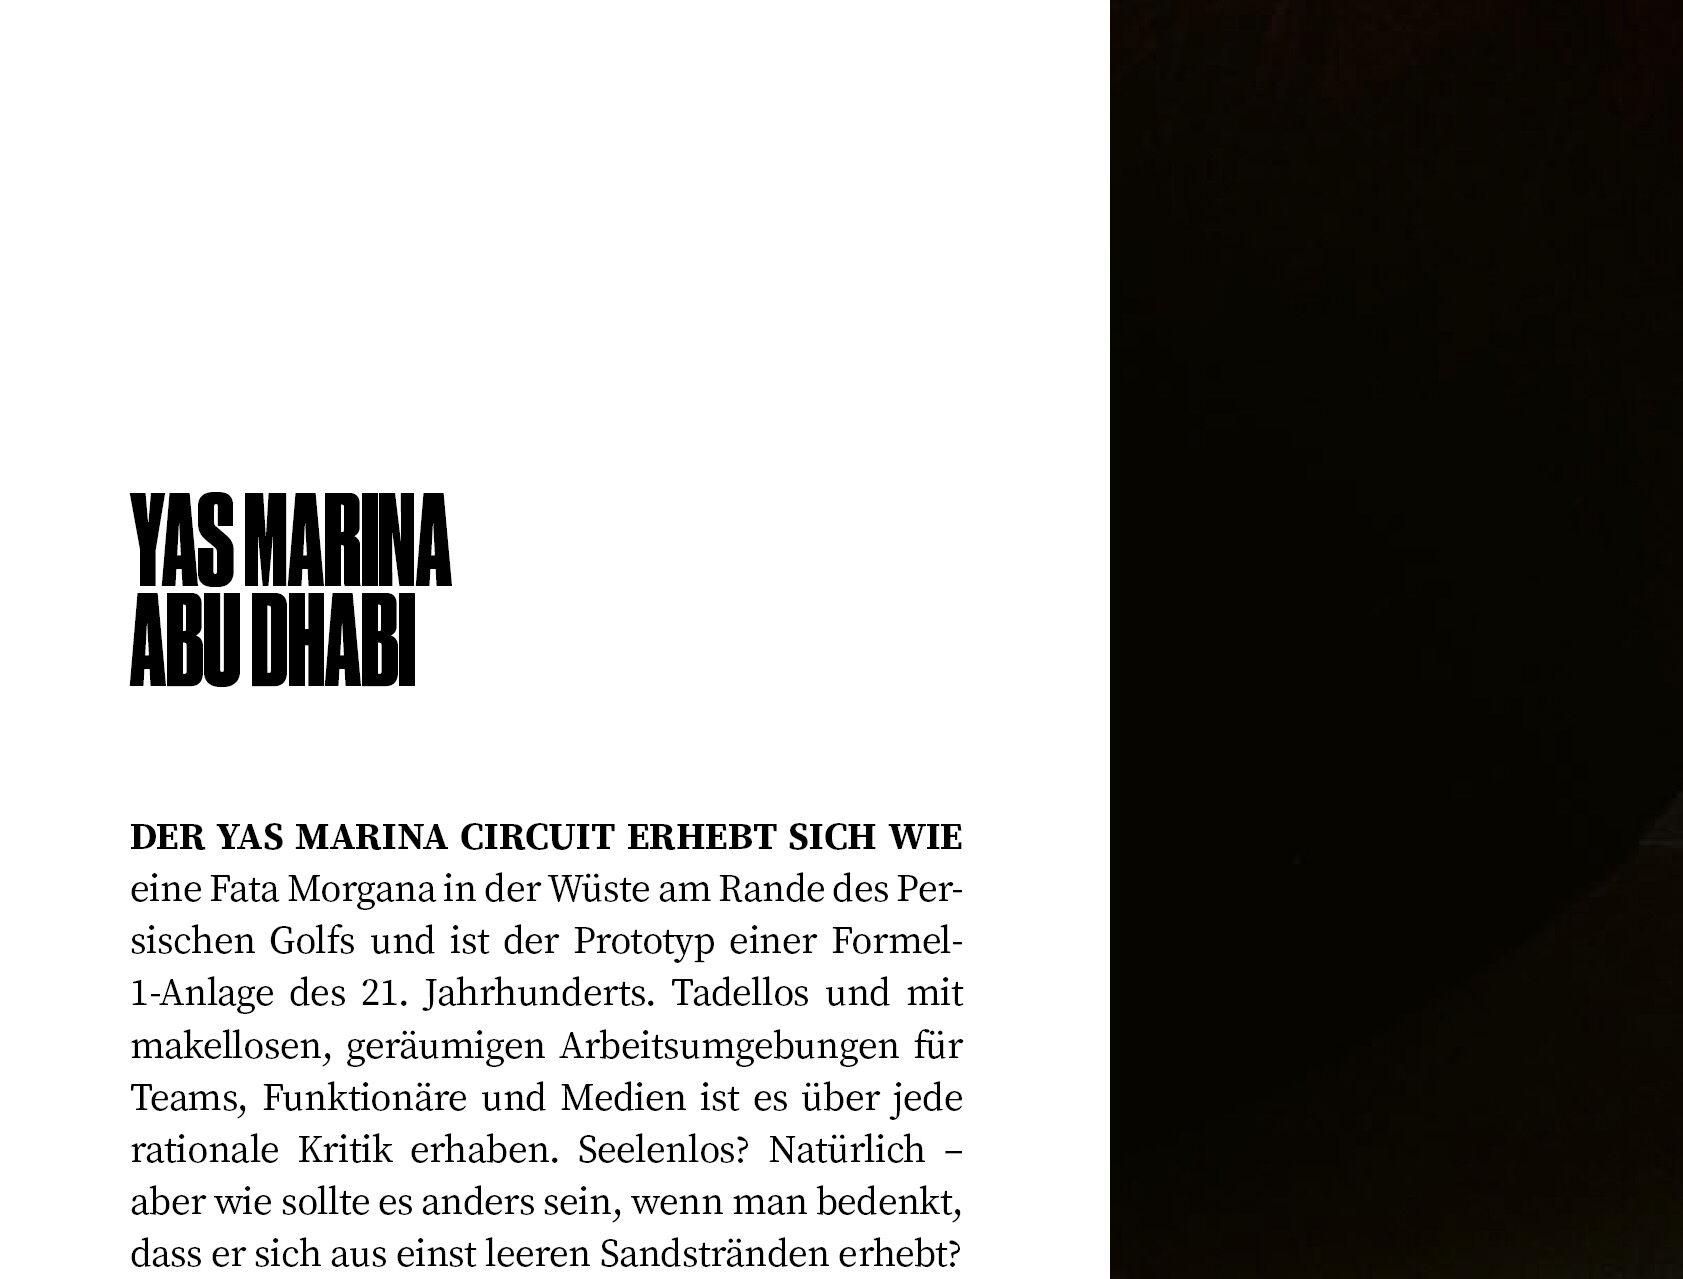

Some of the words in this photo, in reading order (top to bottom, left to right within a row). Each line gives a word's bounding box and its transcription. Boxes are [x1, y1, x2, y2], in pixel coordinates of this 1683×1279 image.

[130, 492, 234, 587] YAS
[245, 493, 452, 586] MARINA
[130, 593, 240, 687] ABU
[252, 593, 415, 686] DHABI
[131, 824, 205, 850] DER
[217, 823, 283, 850] YAS
[296, 824, 448, 850] MARINA
[461, 823, 615, 850] CIRCUIT
[628, 824, 777, 850] ERHEBT
[790, 823, 875, 850] SICH
[889, 824, 961, 849] WIE
[132, 873, 201, 902] eine
[211, 875, 279, 902] Fata
[289, 875, 436, 910] Morgana
[444, 873, 476, 901] in
[486, 872, 541, 902] der
[548, 874, 649, 902] Wüste
[660, 882, 711, 902] am
[720, 872, 824, 902] Rande
[834, 872, 888, 902] des
[898, 875, 962, 902] Per-
[133, 976, 273, 1014] 1-Anlage
[291, 976, 345, 1006] des
[363, 979, 406, 1006] 21.
[423, 976, 653, 1011] Jahrhunderts.
[672, 976, 808, 1006] Tadellos
[826, 976, 890, 1006] und
[908, 977, 963, 1006] mit
[132, 1029, 330, 1066] makellosen,
[347, 1030, 545, 1067] geräumigen
[559, 1029, 899, 1067] Arbeitsumgebungen
[915, 1029, 963, 1059] für
[131, 1084, 245, 1118] Teams,
[264, 1081, 466, 1111] Funktionäre
[482, 1081, 546, 1111] und
[562, 1081, 686, 1111] Medien
[701, 1082, 739, 1111] ist
[755, 1091, 787, 1111] es
[802, 1081, 880, 1111] über
[890, 1081, 962, 1120] jede
[132, 1237, 201, 1267] dass
[213, 1247, 246, 1267] er
[256, 1237, 321, 1267] sich
[332, 1247, 386, 1267] aus
[398, 1238, 476, 1267] einst
[486, 1237, 590, 1267] leeren
[602, 1237, 829, 1267] Sandstränden
[840, 1237, 960, 1267] erhebt?
